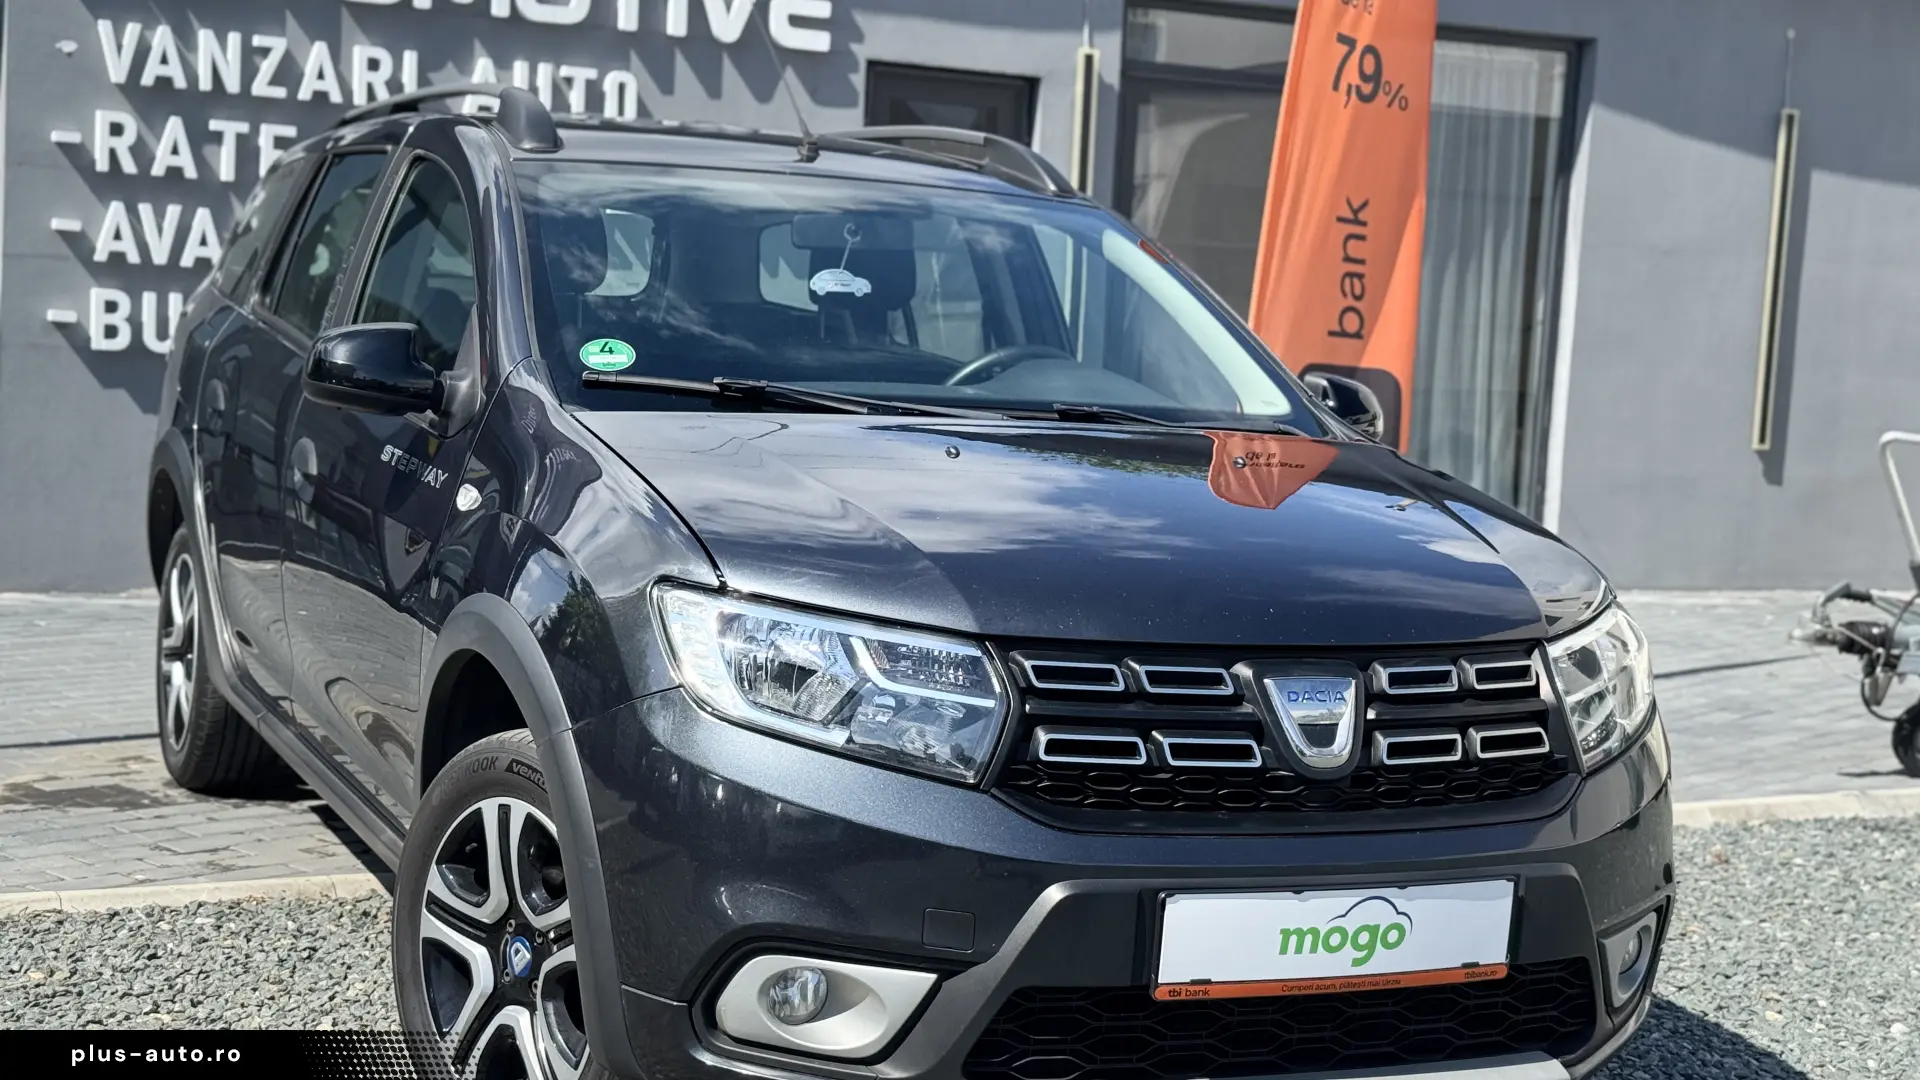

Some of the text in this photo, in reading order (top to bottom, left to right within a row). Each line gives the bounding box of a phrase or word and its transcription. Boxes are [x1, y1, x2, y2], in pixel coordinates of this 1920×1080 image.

[461, 56, 638, 122] AUTO
[1328, 197, 1370, 340] bank
[599, 341, 616, 355] 4
[380, 444, 449, 489] STEPWAY
[1286, 690, 1347, 703] DACIA
[1278, 922, 1406, 968] mogo
[1167, 986, 1211, 998] tbi bank
